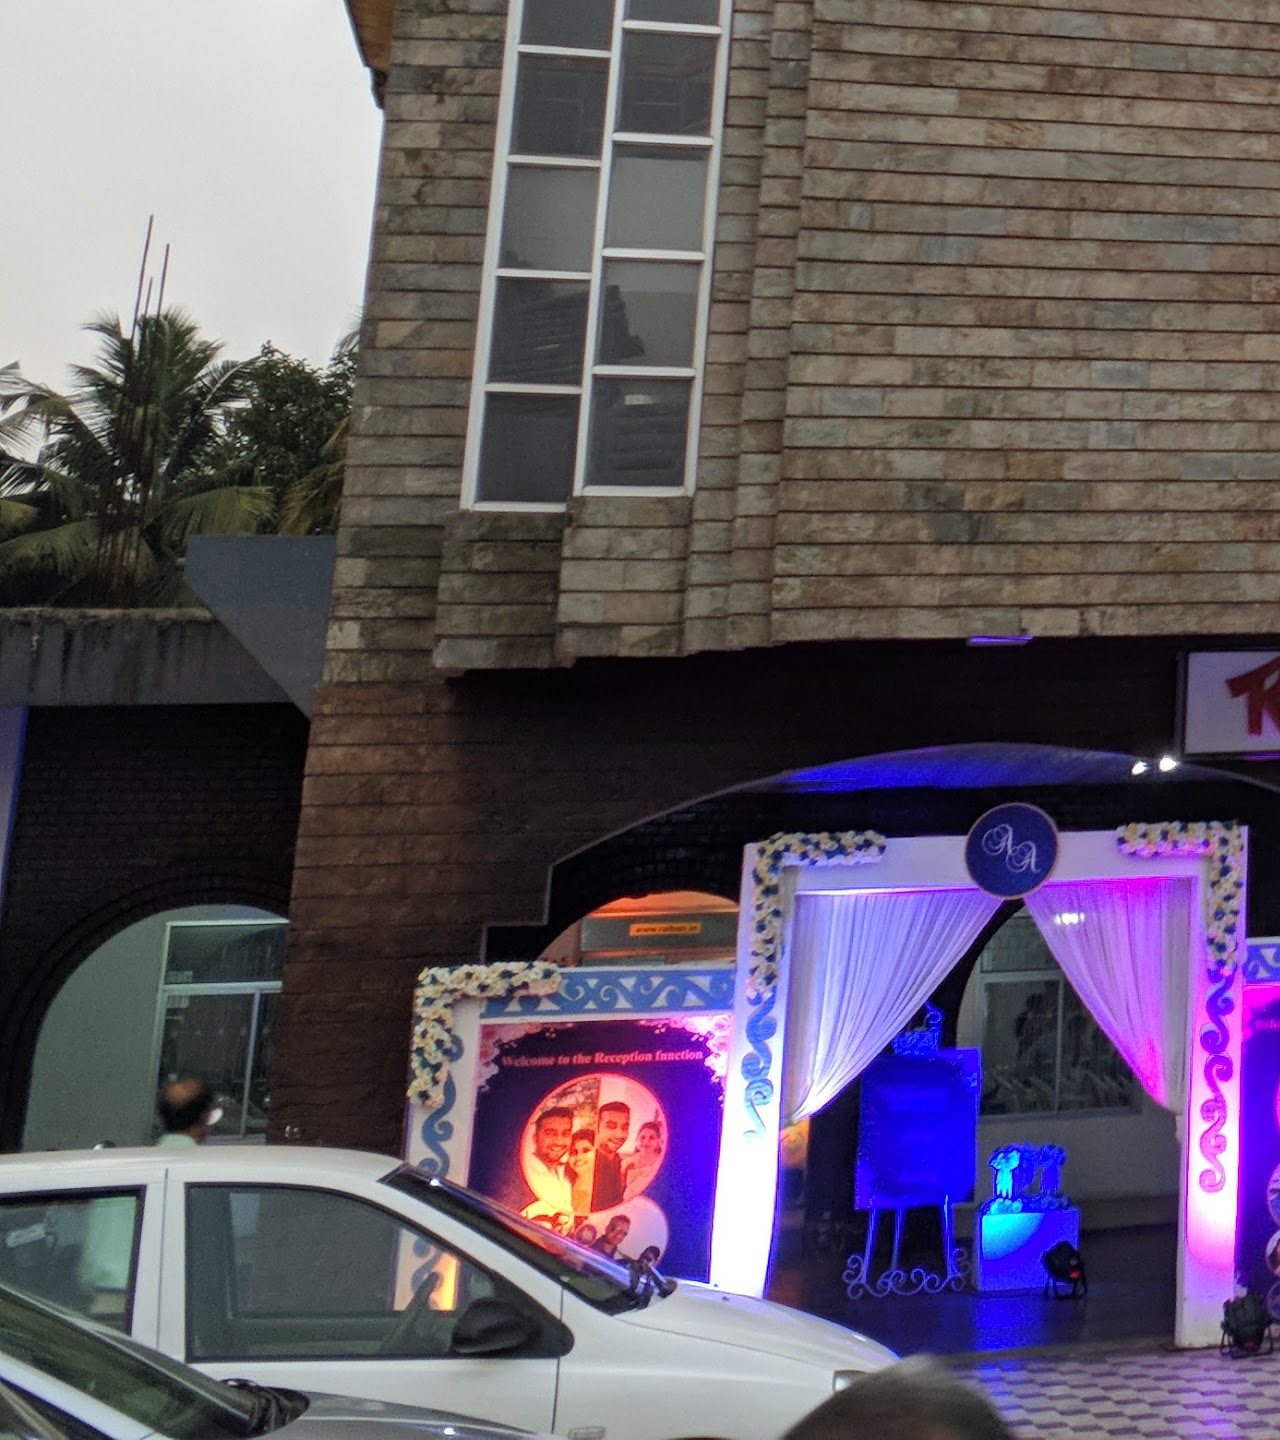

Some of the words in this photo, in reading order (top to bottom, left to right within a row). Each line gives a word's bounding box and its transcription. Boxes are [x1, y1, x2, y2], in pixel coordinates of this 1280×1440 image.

[501, 1055, 555, 1068] Welcome
[557, 1054, 570, 1066] to
[572, 1053, 593, 1065] the
[594, 1050, 653, 1066] Reception
[654, 1048, 704, 1062] function
